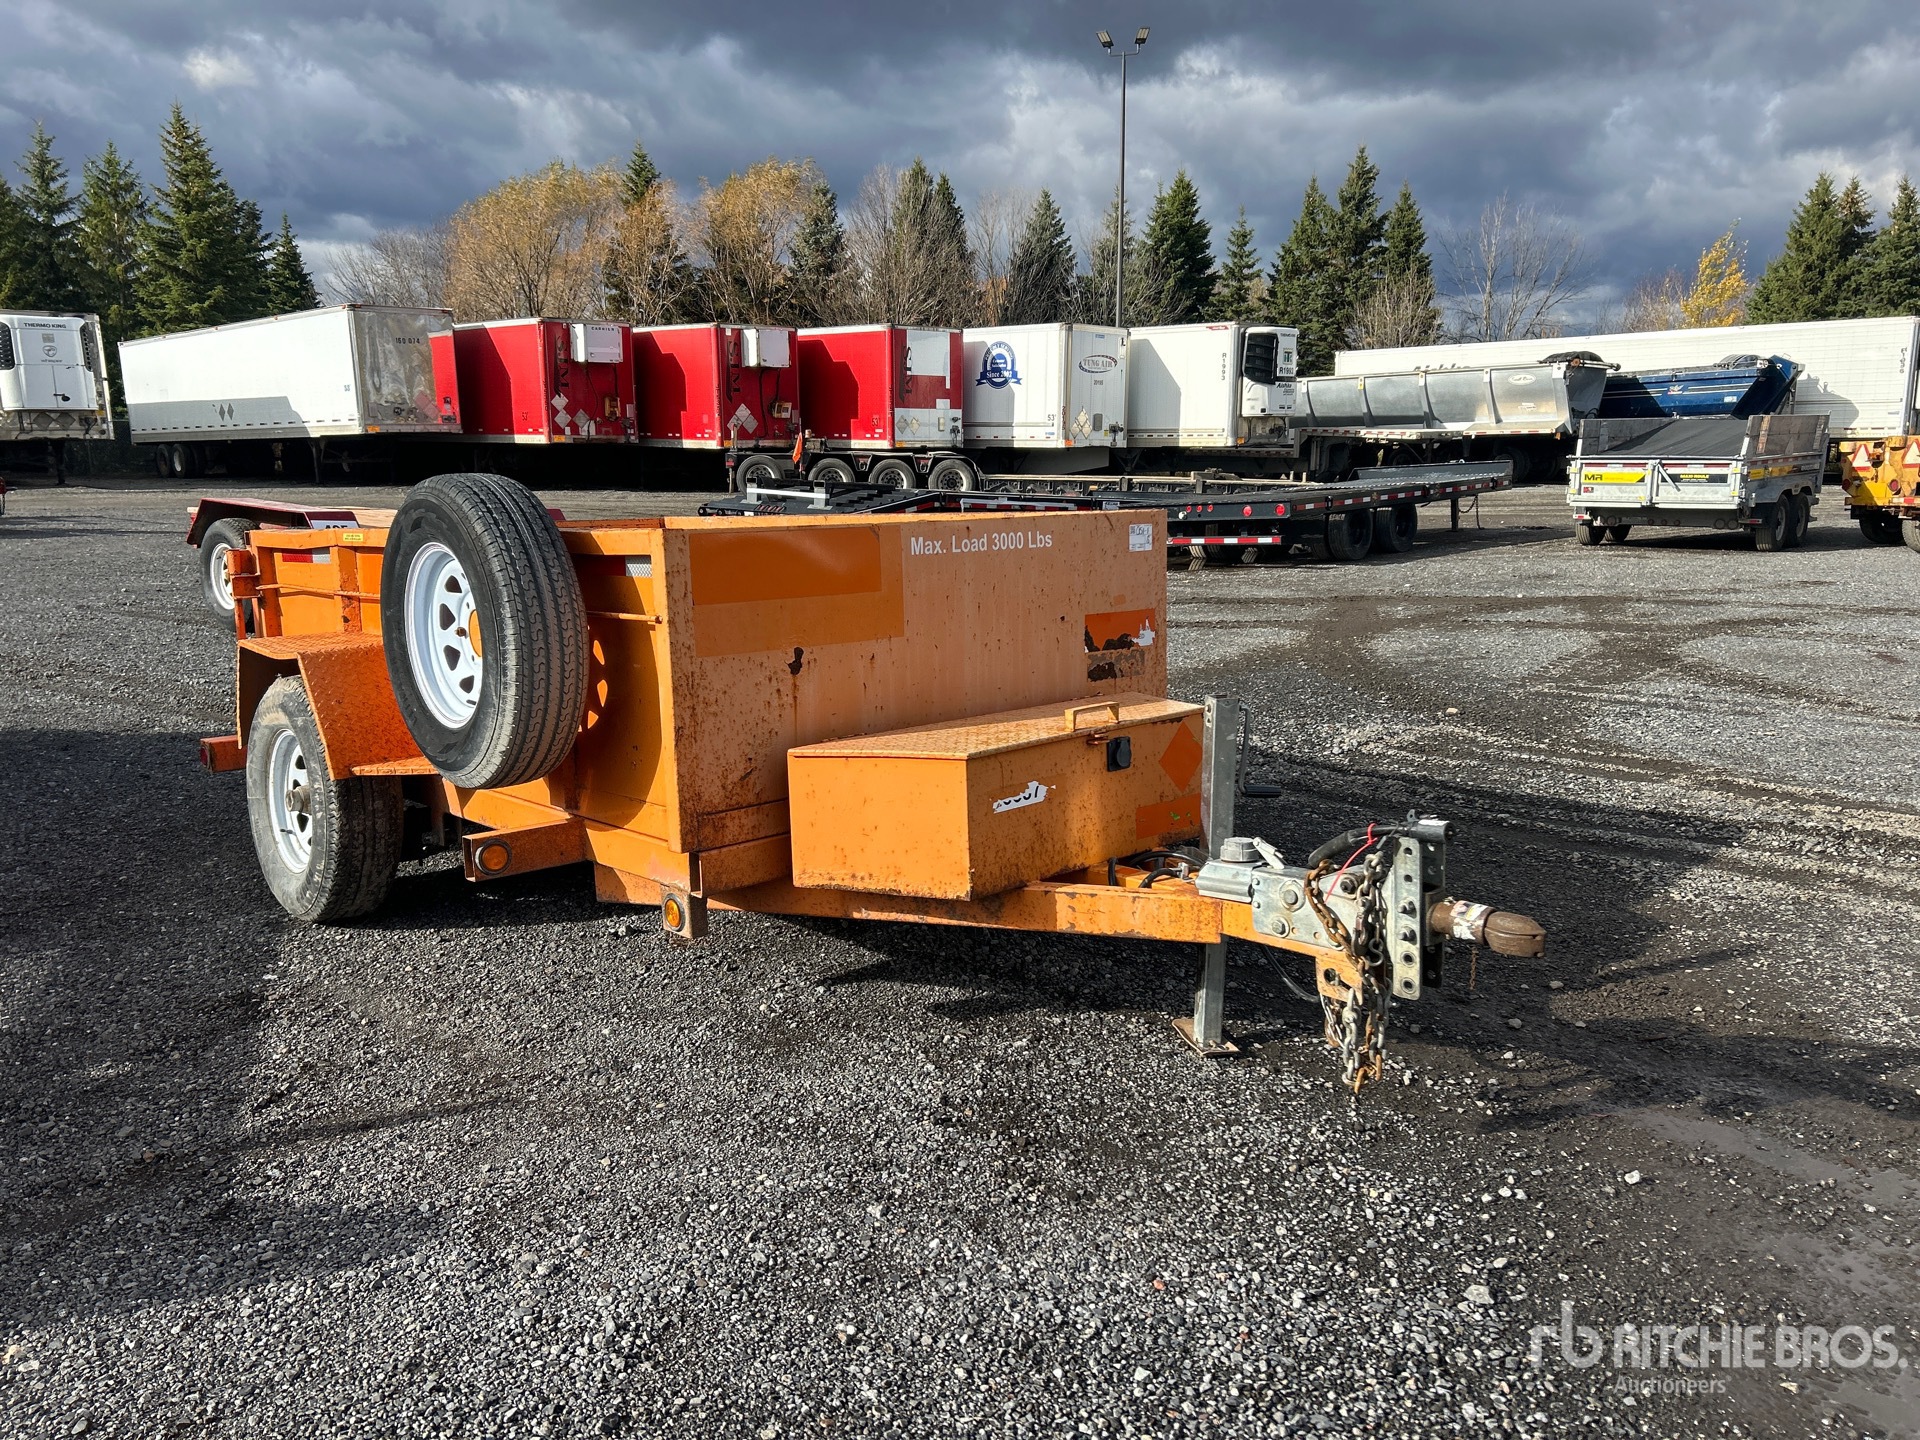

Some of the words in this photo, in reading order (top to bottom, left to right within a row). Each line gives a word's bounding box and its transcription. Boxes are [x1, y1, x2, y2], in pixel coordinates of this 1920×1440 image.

[1101, 360, 1113, 368] AIR
[986, 370, 1000, 378] Since
[1584, 473, 1603, 481] MR
[911, 536, 947, 555] Max.
[952, 533, 988, 553] Load
[992, 531, 1024, 551] 3000
[1028, 531, 1053, 548] Lbs
